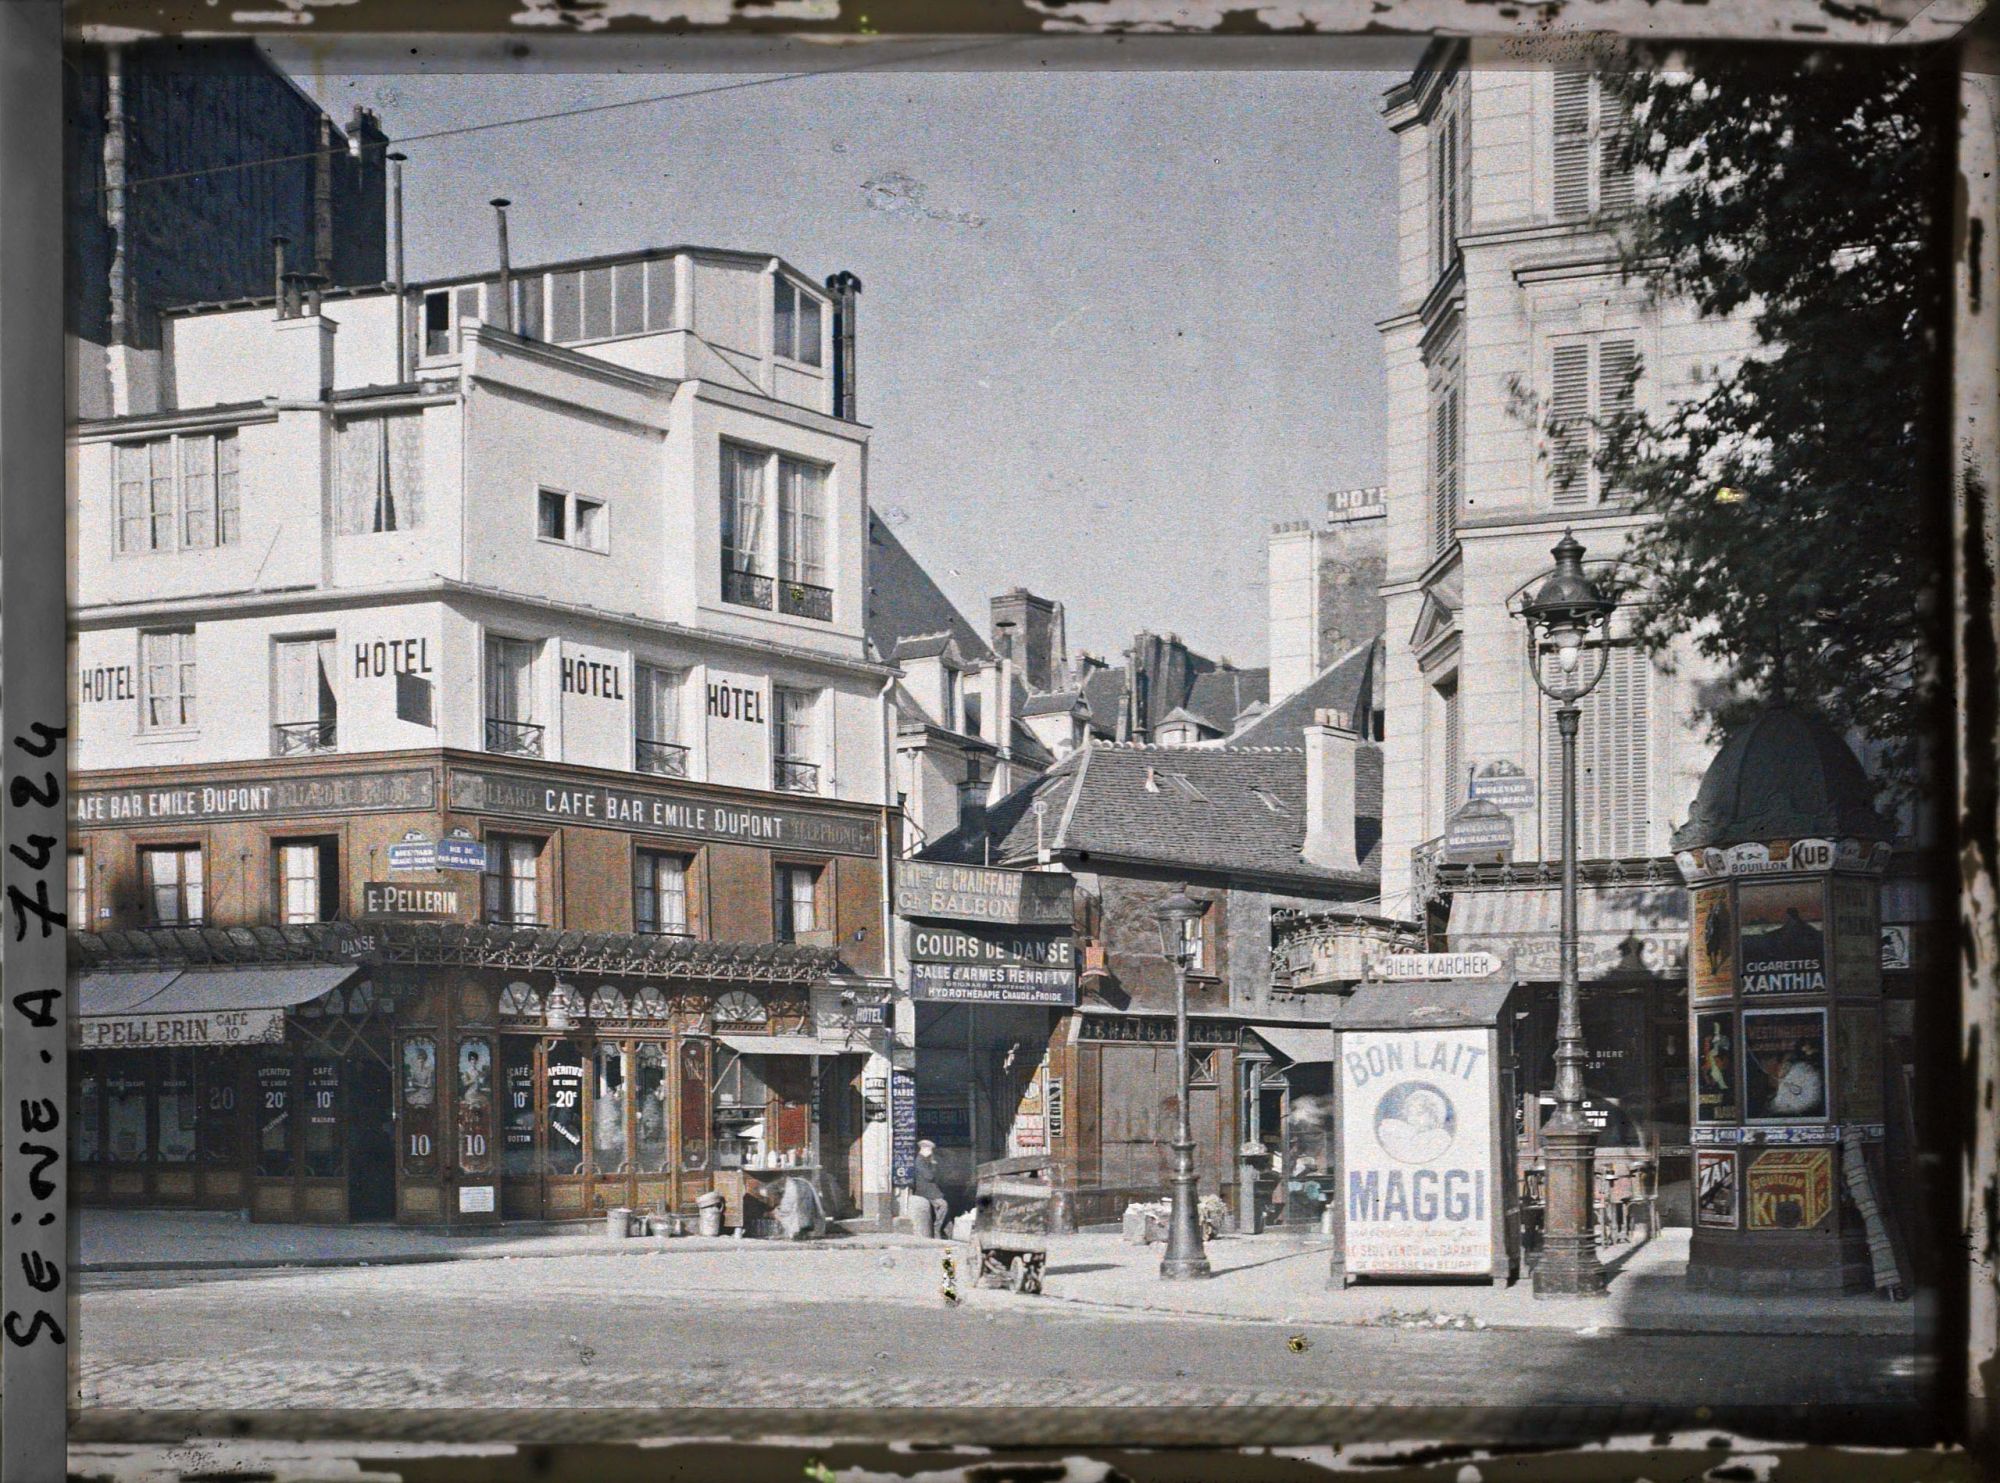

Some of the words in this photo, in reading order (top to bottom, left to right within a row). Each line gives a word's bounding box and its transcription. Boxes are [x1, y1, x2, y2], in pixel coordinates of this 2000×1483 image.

[356, 636, 432, 679] HÔTEL
[82, 662, 135, 703] HÔTEL
[562, 654, 623, 701] HÔTEL
[707, 680, 764, 724] HÔTEL
[110, 794, 142, 818] BAR
[202, 786, 271, 813] DUPONT
[607, 797, 643, 823] BAR
[714, 808, 783, 838] DUPONT
[1731, 862, 1788, 874] BOUILLON
[1791, 842, 1829, 870] KUB
[341, 935, 376, 954] DANSE
[916, 933, 979, 958] COURS
[985, 941, 1005, 960] DE
[1013, 940, 1069, 964] DANSE
[915, 964, 951, 980] SALLE
[953, 966, 1005, 983] d'ARMES
[1009, 970, 1048, 984] HENRI
[1052, 971, 1071, 985] IV
[1427, 954, 1490, 975] KARCHER
[1746, 958, 1820, 972] CIGARETTES
[1741, 972, 1826, 994] XANTHIA
[97, 1019, 208, 1044] PELLERIN
[225, 1026, 240, 1040] 10
[547, 1062, 584, 1078] APÉRITIFS
[1345, 1041, 1406, 1088] BON
[1414, 1040, 1487, 1081] LAIT
[411, 1134, 430, 1156] 10
[466, 1134, 485, 1156] 10
[1700, 1159, 1732, 1197] ZAN
[1753, 1174, 1805, 1191] BOUILLON
[1350, 1169, 1484, 1221] MAGGI
